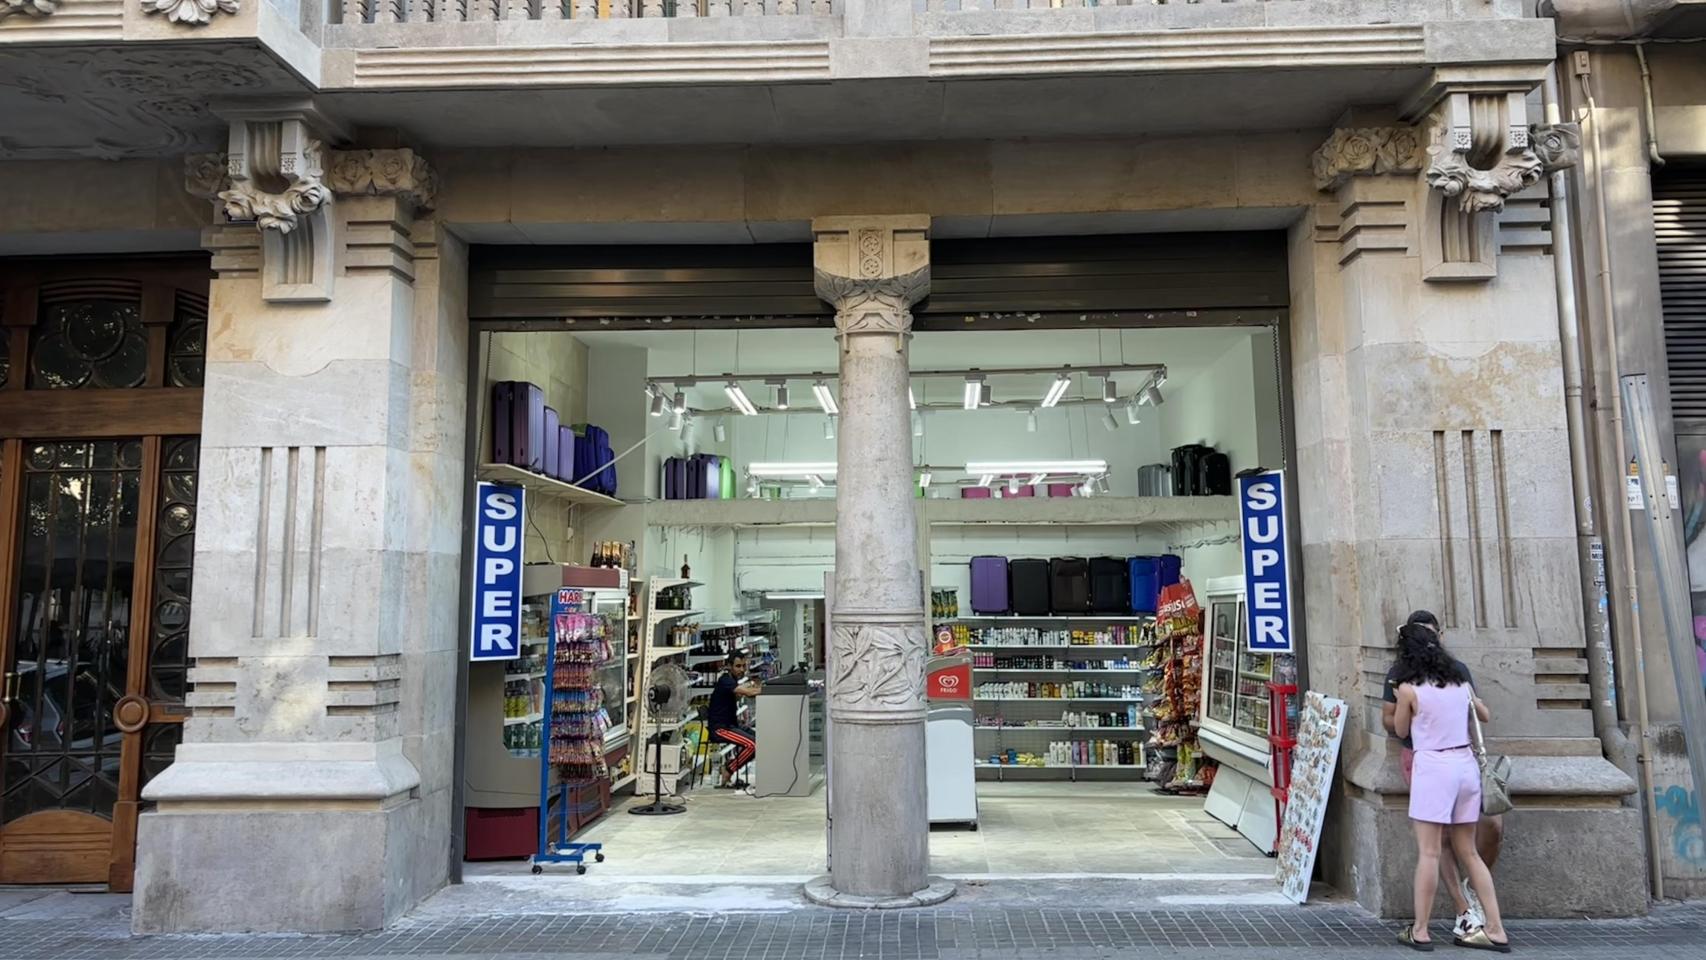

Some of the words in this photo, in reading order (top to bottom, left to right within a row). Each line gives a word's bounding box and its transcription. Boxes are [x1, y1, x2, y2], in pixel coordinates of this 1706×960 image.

[480, 493, 517, 651] SUPER
[1246, 483, 1286, 643] SUPER
[1459, 919, 1473, 932] N
